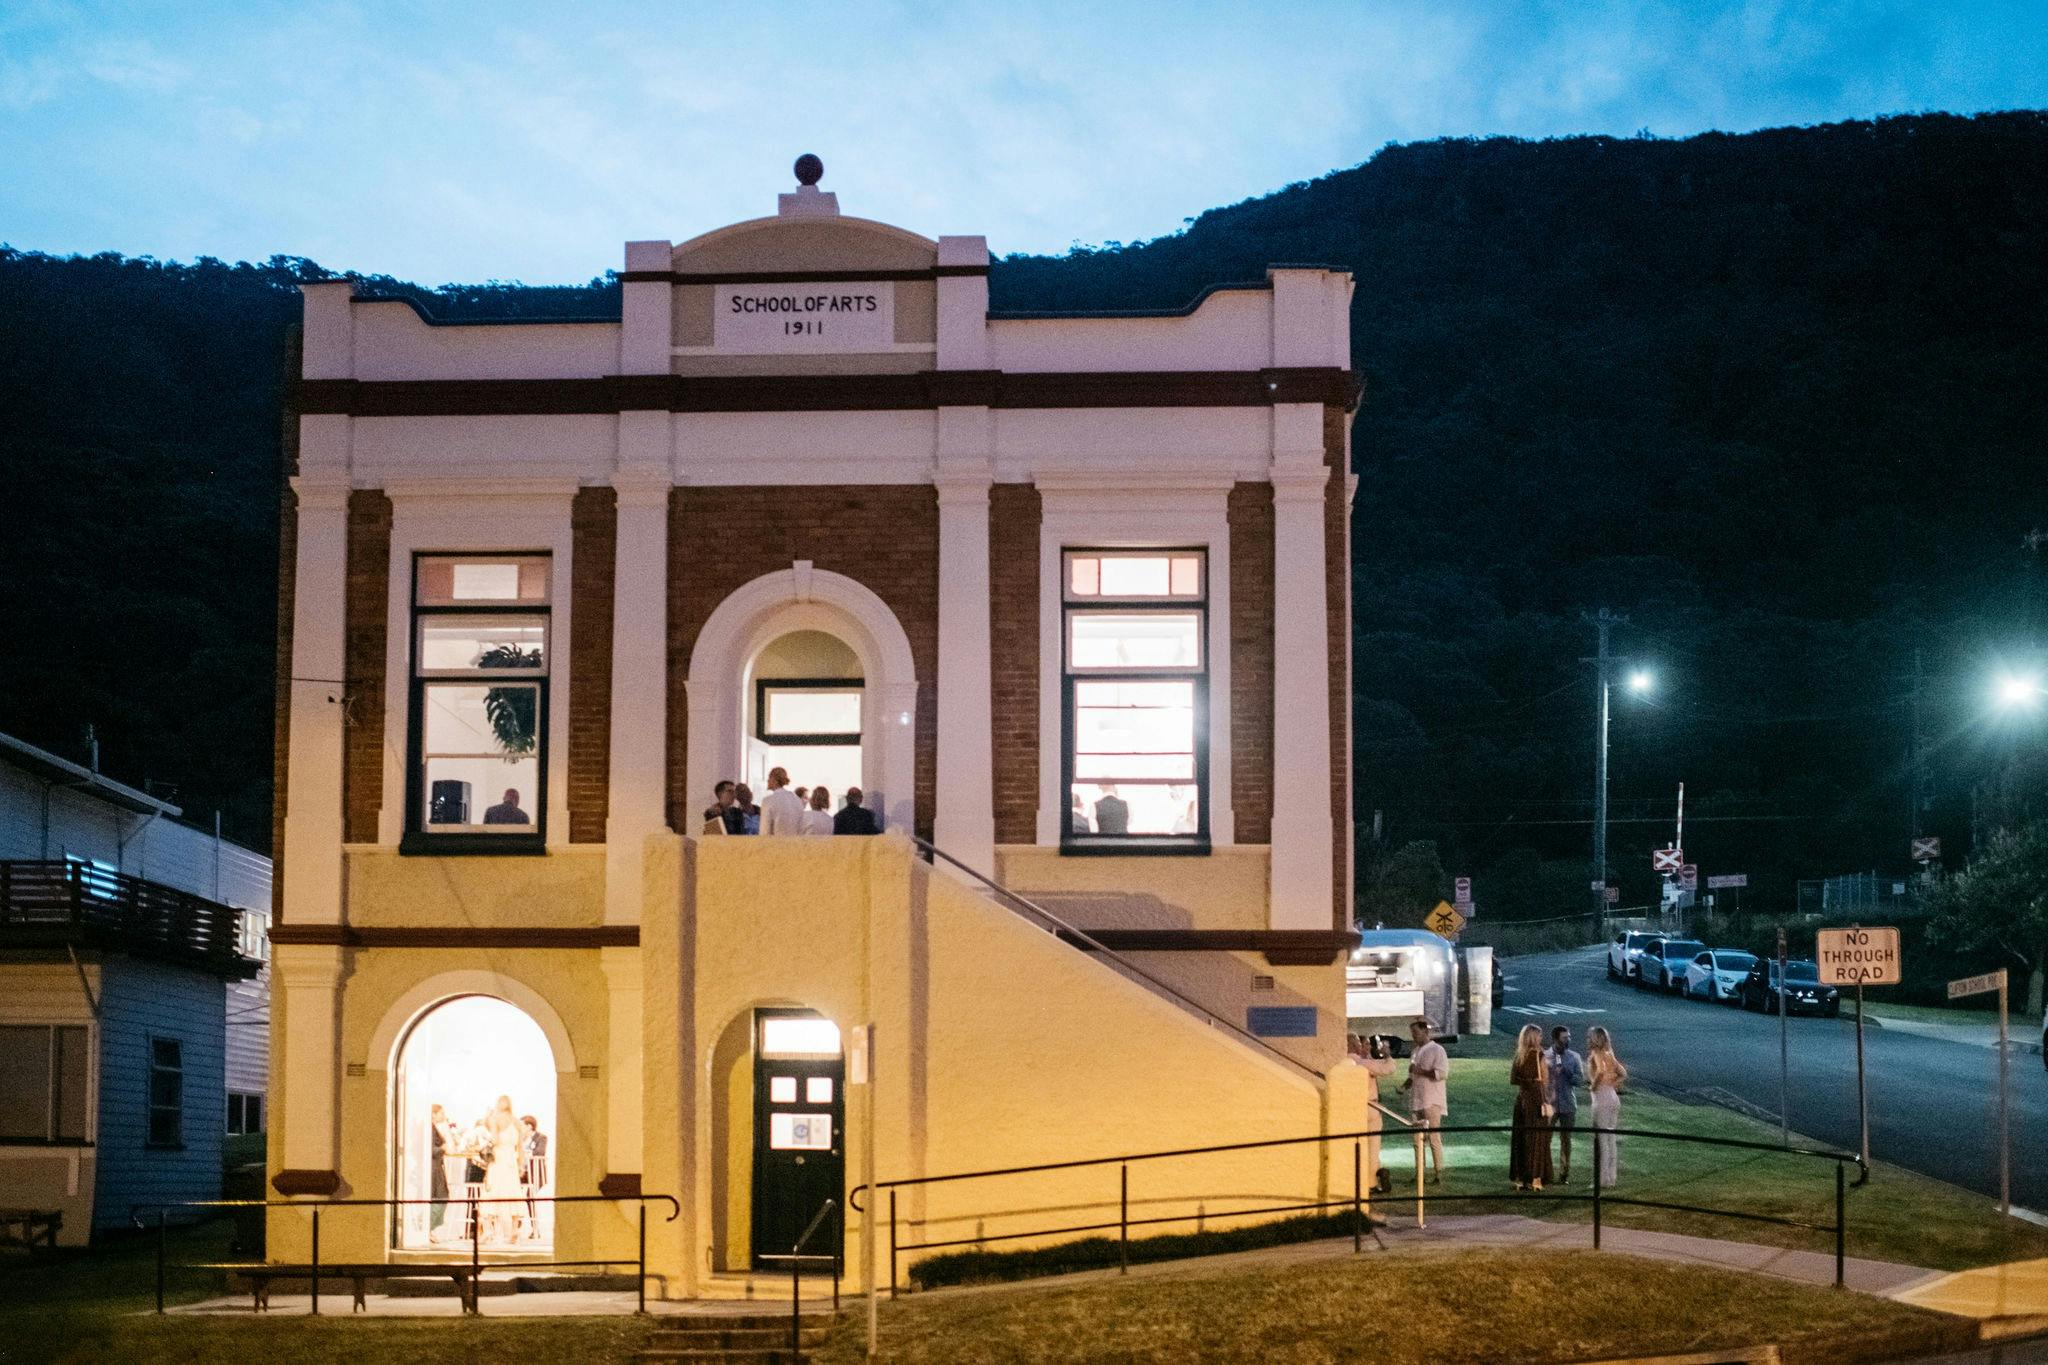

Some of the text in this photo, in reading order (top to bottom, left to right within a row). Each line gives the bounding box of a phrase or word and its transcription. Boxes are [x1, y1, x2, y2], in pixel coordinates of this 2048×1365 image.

[784, 321, 822, 335] 1911
[1846, 933, 1869, 945] NO
[1823, 949, 1894, 963] THROUGH
[1836, 967, 1883, 979] ROAD
